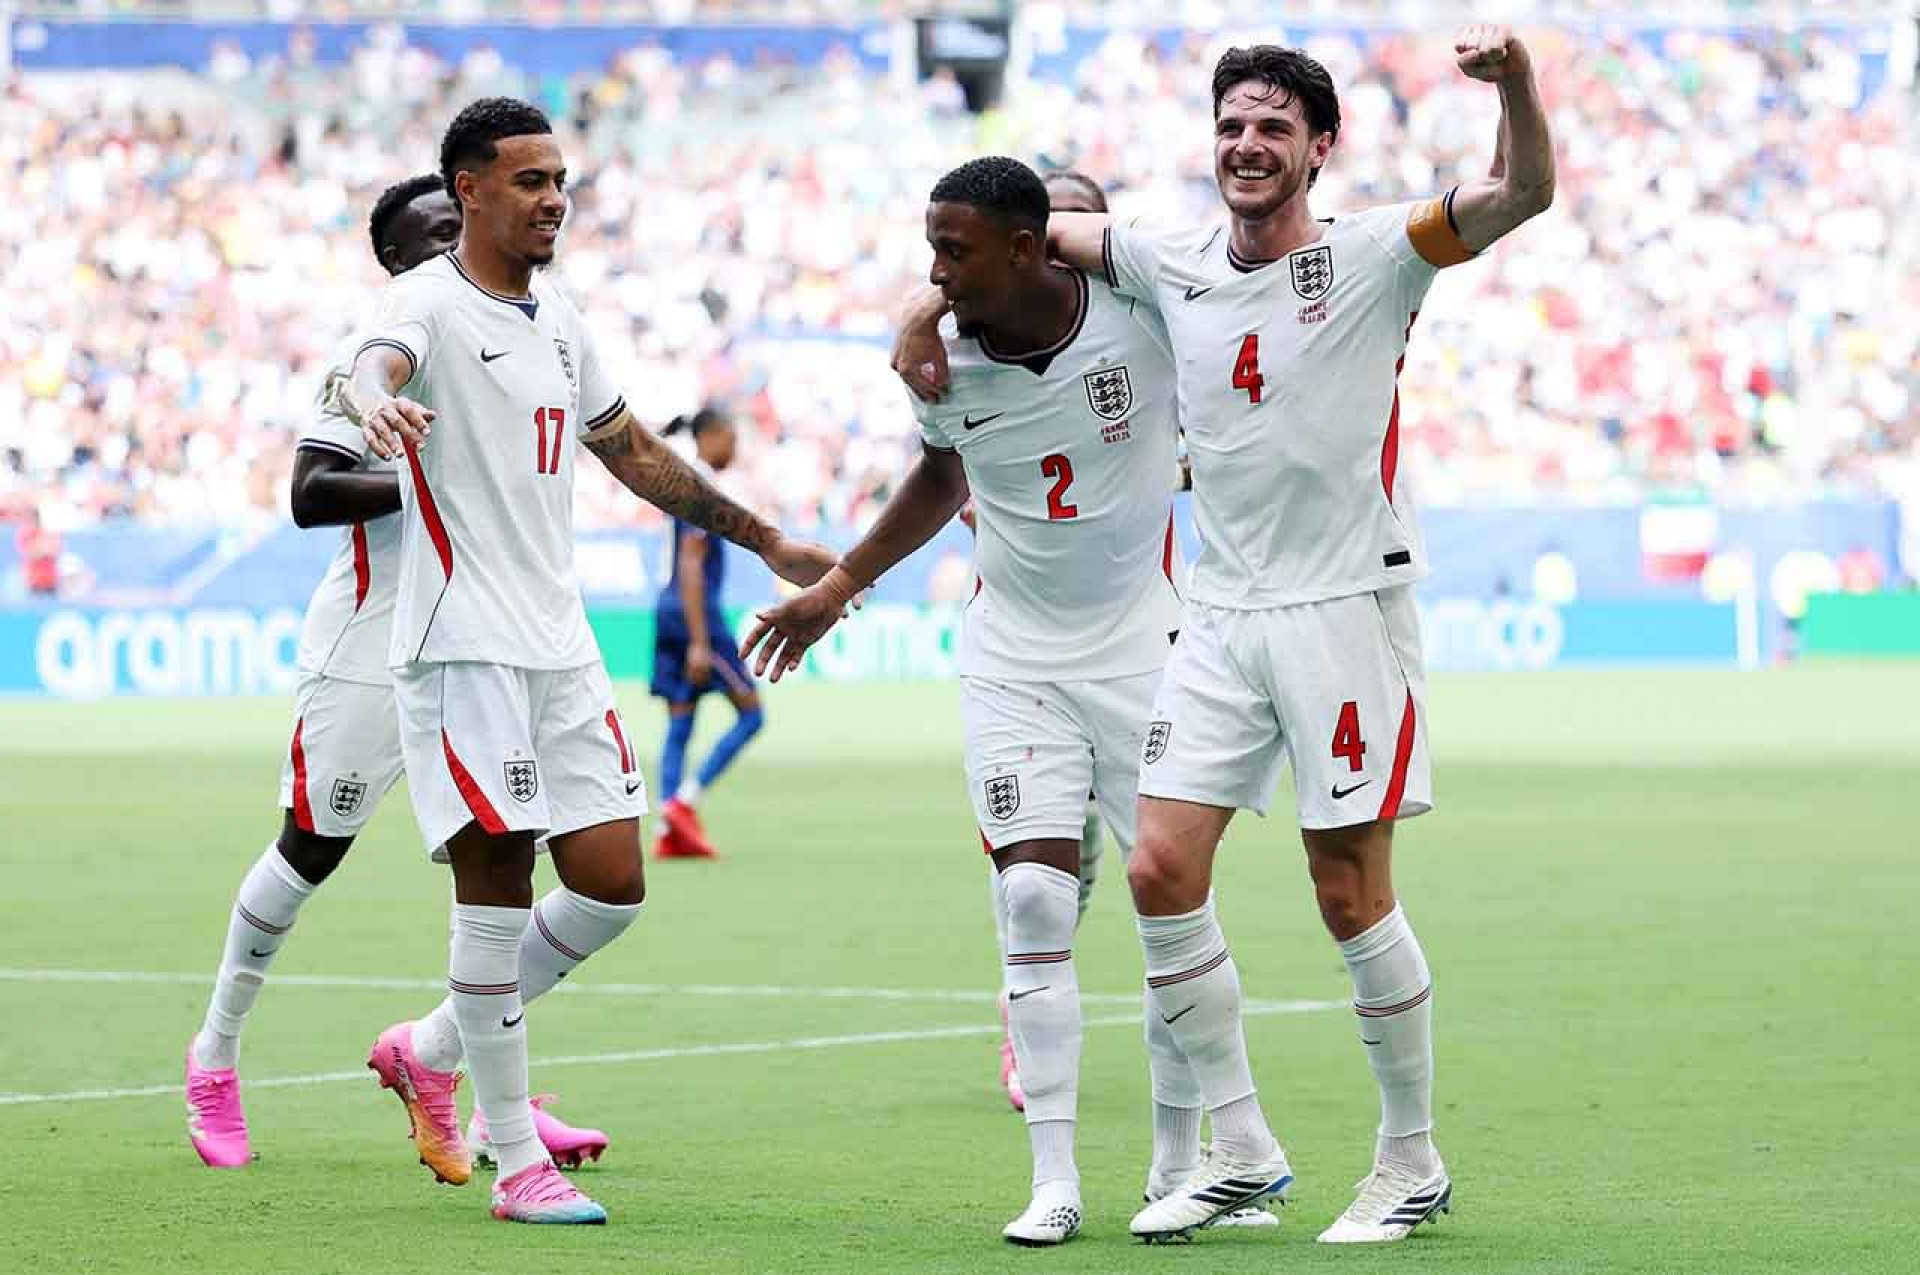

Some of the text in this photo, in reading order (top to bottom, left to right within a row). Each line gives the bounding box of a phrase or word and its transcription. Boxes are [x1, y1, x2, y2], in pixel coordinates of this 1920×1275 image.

[1232, 333, 1264, 403] 4
[534, 406, 565, 475] 17
[1041, 452, 1078, 520] 2
[37, 609, 302, 692] aramc
[1331, 701, 1366, 772] 4
